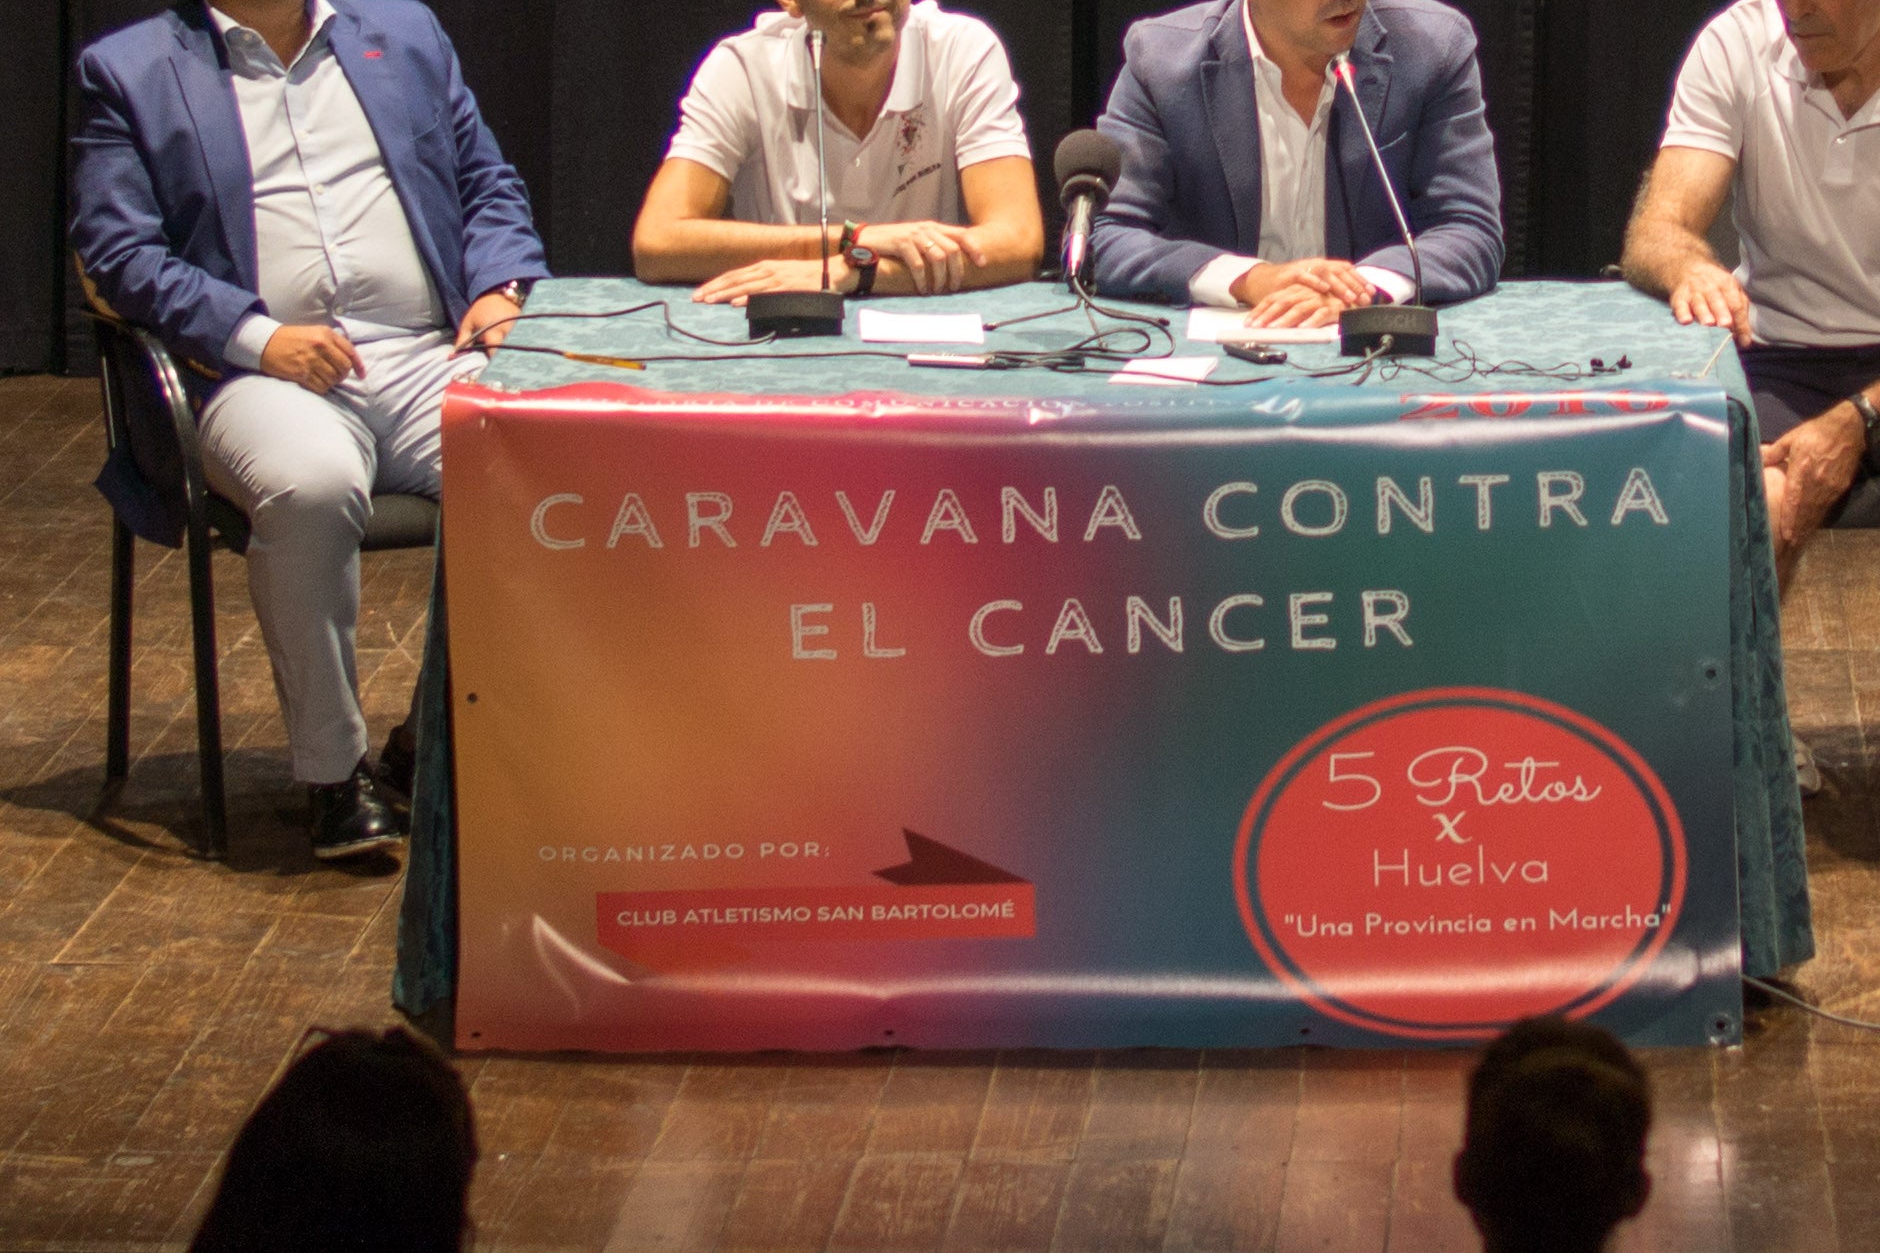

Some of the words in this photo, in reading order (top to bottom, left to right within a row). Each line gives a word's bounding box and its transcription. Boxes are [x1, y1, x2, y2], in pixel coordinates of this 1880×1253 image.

[529, 484, 1142, 550] CARAVANA
[1203, 467, 1671, 539] CONTRA
[790, 601, 906, 661] EL
[968, 589, 1414, 658] CANCER
[1322, 751, 1382, 812] 5
[1407, 745, 1602, 808] Retos
[537, 841, 746, 863] ORGANIZADO
[759, 840, 831, 860] POR:
[1373, 844, 1550, 887] Huelva
[616, 908, 679, 927] CLUB
[682, 905, 811, 925] ATLETISMO
[816, 903, 865, 922] SAN
[870, 898, 1016, 921] BARTOLOMÉ
[1284, 912, 1354, 938] "Una
[1365, 910, 1492, 936] Provincia
[1503, 914, 1537, 933] en
[1548, 902, 1672, 931] Marcha"
